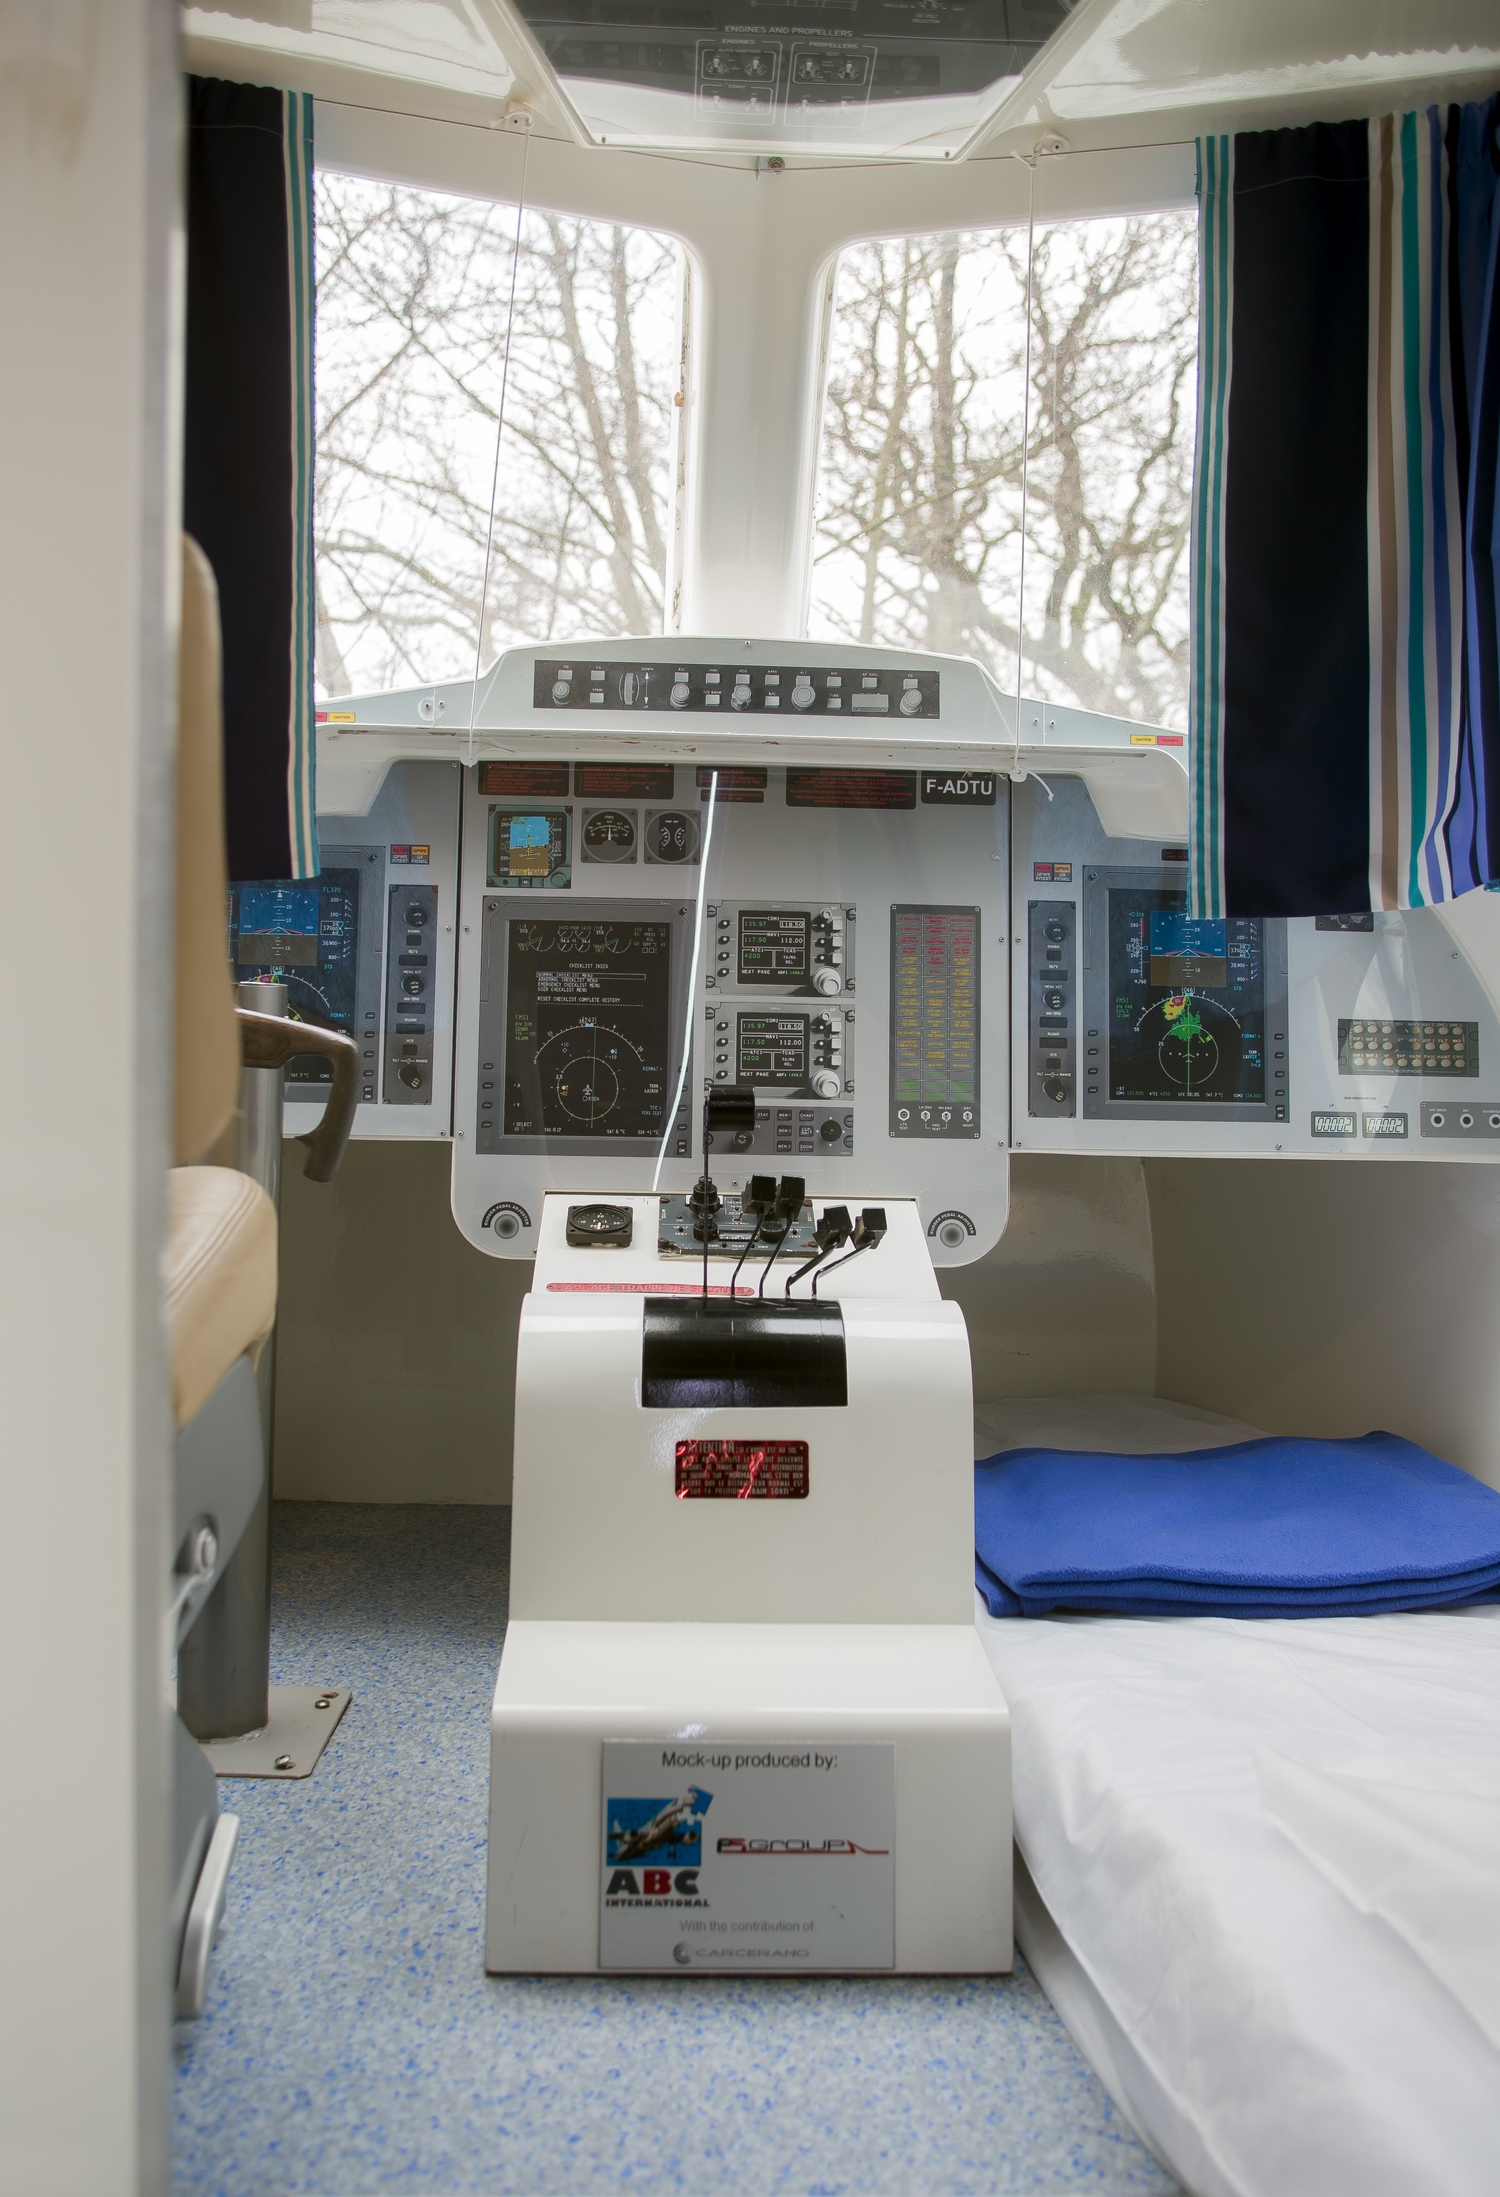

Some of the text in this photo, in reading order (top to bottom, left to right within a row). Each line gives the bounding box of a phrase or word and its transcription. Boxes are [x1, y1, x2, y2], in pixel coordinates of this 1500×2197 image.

[725, 26, 853, 37] ENGINES AND PROPELLERS
[926, 779, 992, 795] F-ADTU
[1316, 1117, 1352, 1132] 00002
[1367, 1119, 1403, 1133] 00002
[484, 1208, 496, 1226] RUDDER
[512, 1205, 529, 1225] ADJUSTER
[930, 1218, 941, 1235] RUDDER
[957, 1214, 974, 1234] ADJUSTER
[621, 1284, 665, 1292] TRAPPE
[669, 1285, 685, 1293] DE
[662, 1751, 838, 1771] Mock-up produced by:
[605, 1869, 700, 1895] ABC
[605, 1898, 710, 1907] INTERNATIONAL
[680, 1920, 817, 1932] With the contribution of:
[695, 1948, 810, 1957] CARCERANO
